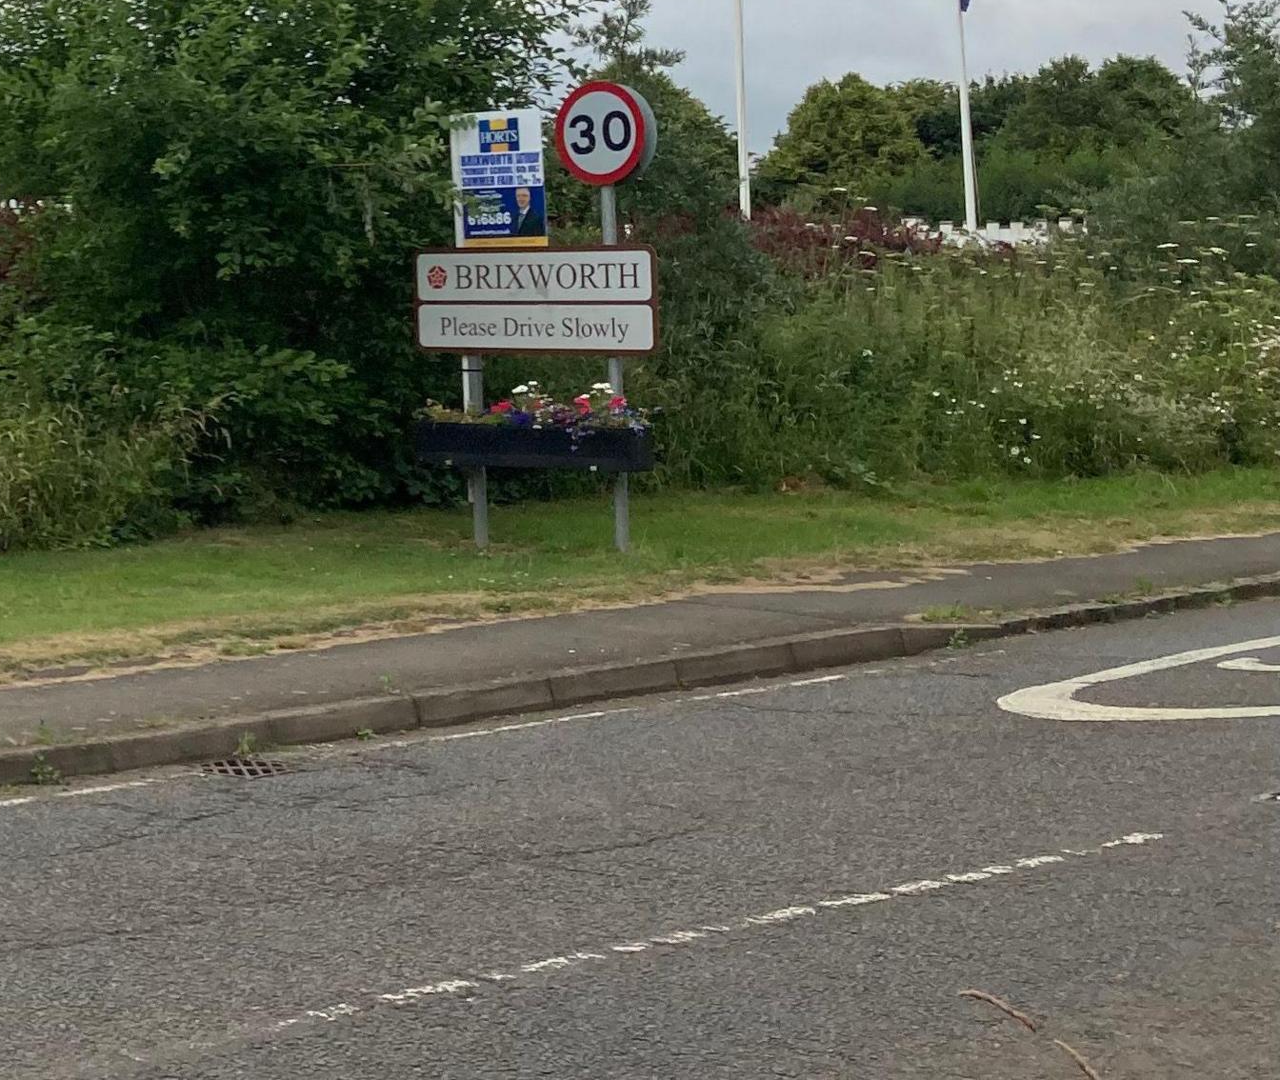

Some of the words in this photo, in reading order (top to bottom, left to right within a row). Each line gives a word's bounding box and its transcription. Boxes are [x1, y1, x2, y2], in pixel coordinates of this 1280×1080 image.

[480, 129, 518, 144] HORTS
[569, 110, 632, 155] 30
[455, 262, 640, 290] BRIXWORTH
[440, 317, 497, 337] Please
[503, 317, 555, 337] Drive
[561, 317, 630, 343] Slowly
